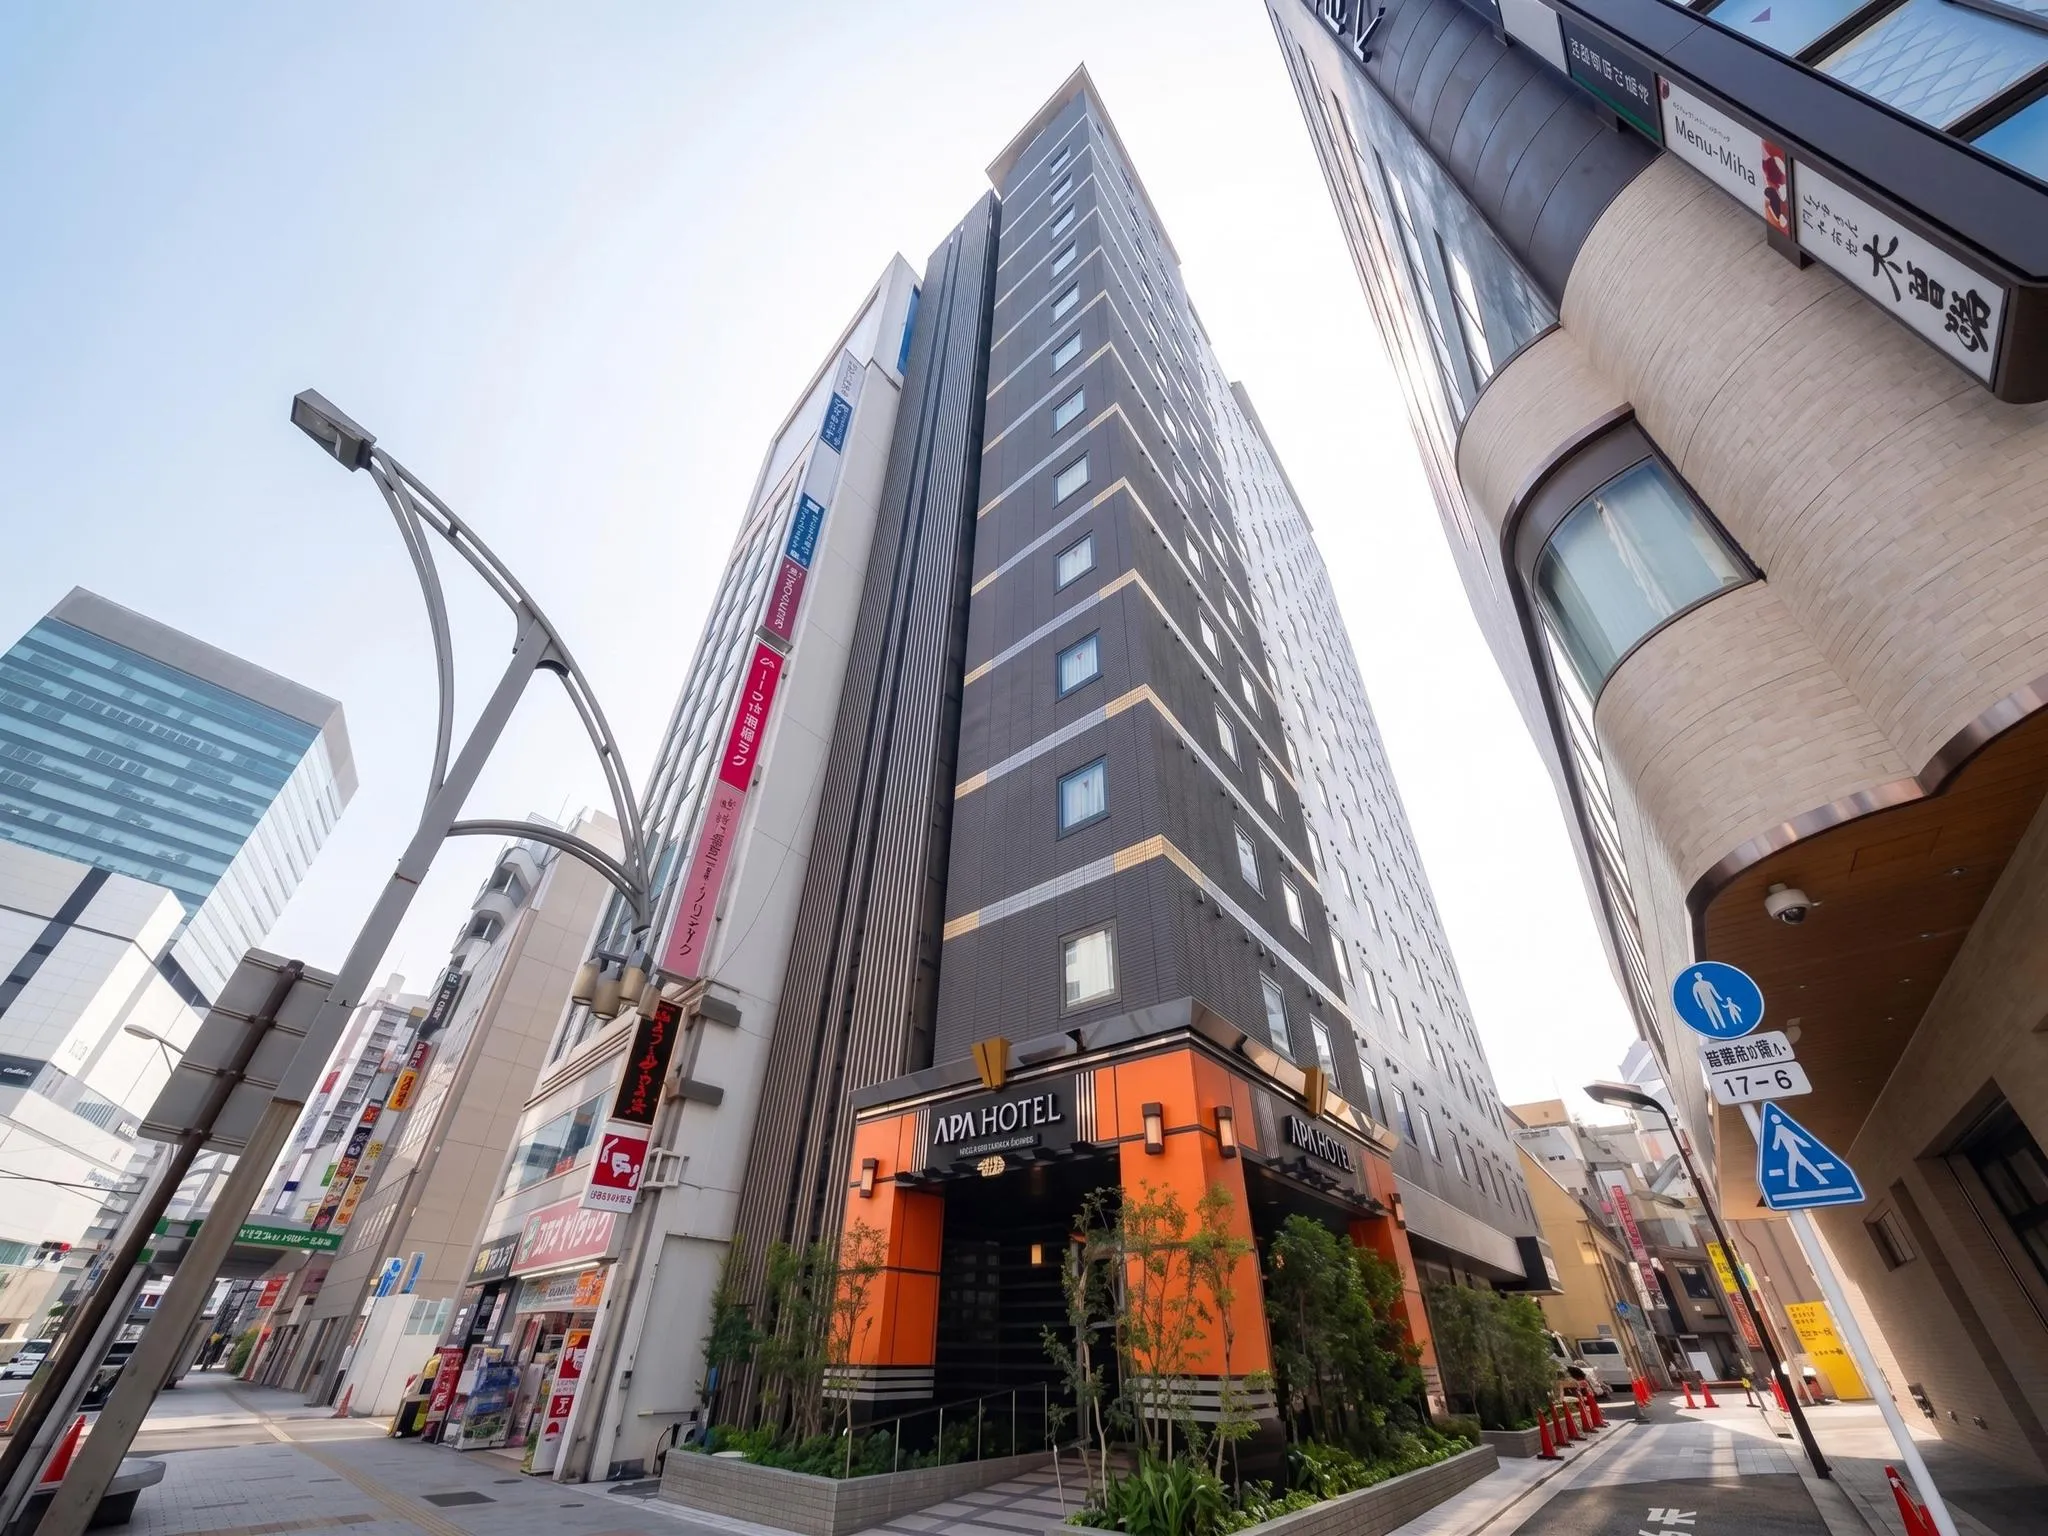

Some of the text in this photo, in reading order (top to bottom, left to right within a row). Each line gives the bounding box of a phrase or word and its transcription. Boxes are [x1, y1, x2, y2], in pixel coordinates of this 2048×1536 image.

[1675, 116, 1756, 186] Menu-Miha
[1723, 1069, 1793, 1097] 17-6
[933, 1093, 1061, 1145] APA HOTEL
[1291, 1115, 1319, 1155] APA
[1316, 1130, 1356, 1173] HOTEL
